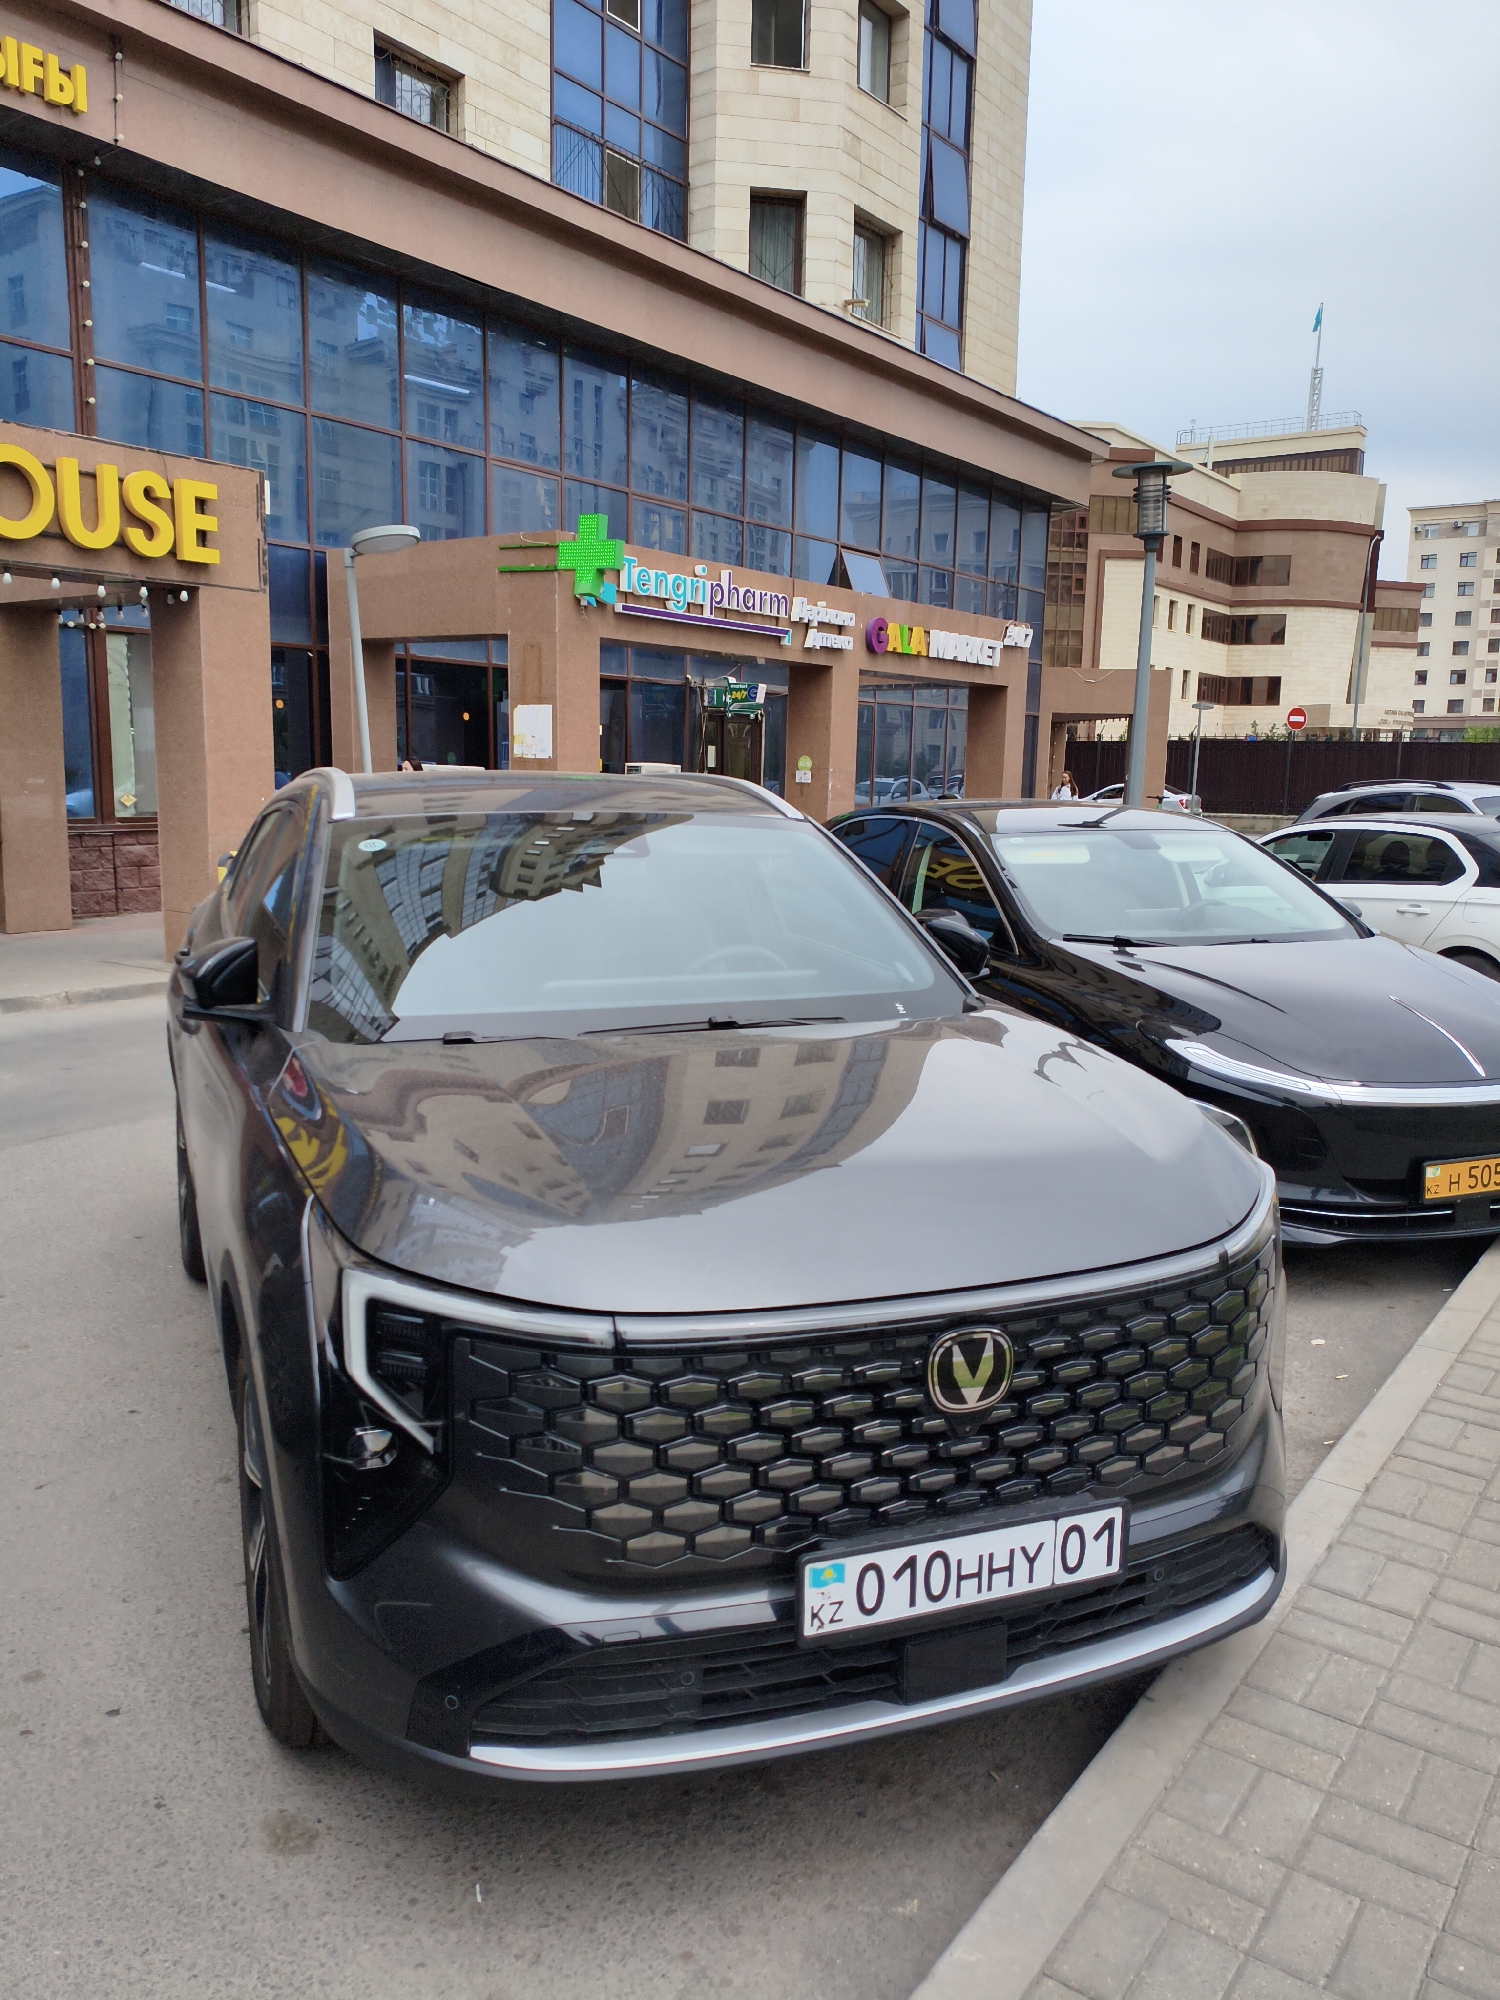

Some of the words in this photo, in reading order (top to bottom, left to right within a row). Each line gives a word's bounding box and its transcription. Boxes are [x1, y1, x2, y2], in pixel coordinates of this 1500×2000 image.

[620, 556, 789, 618] Tengripharm
[866, 617, 928, 657] GALA
[928, 629, 1003, 667] MARKET
[731, 689, 748, 700] 24/7
[1426, 1184, 1440, 1196] KZ
[1448, 1172, 1461, 1193] H
[1059, 1516, 1117, 1576] 01
[809, 1600, 844, 1628] KZ
